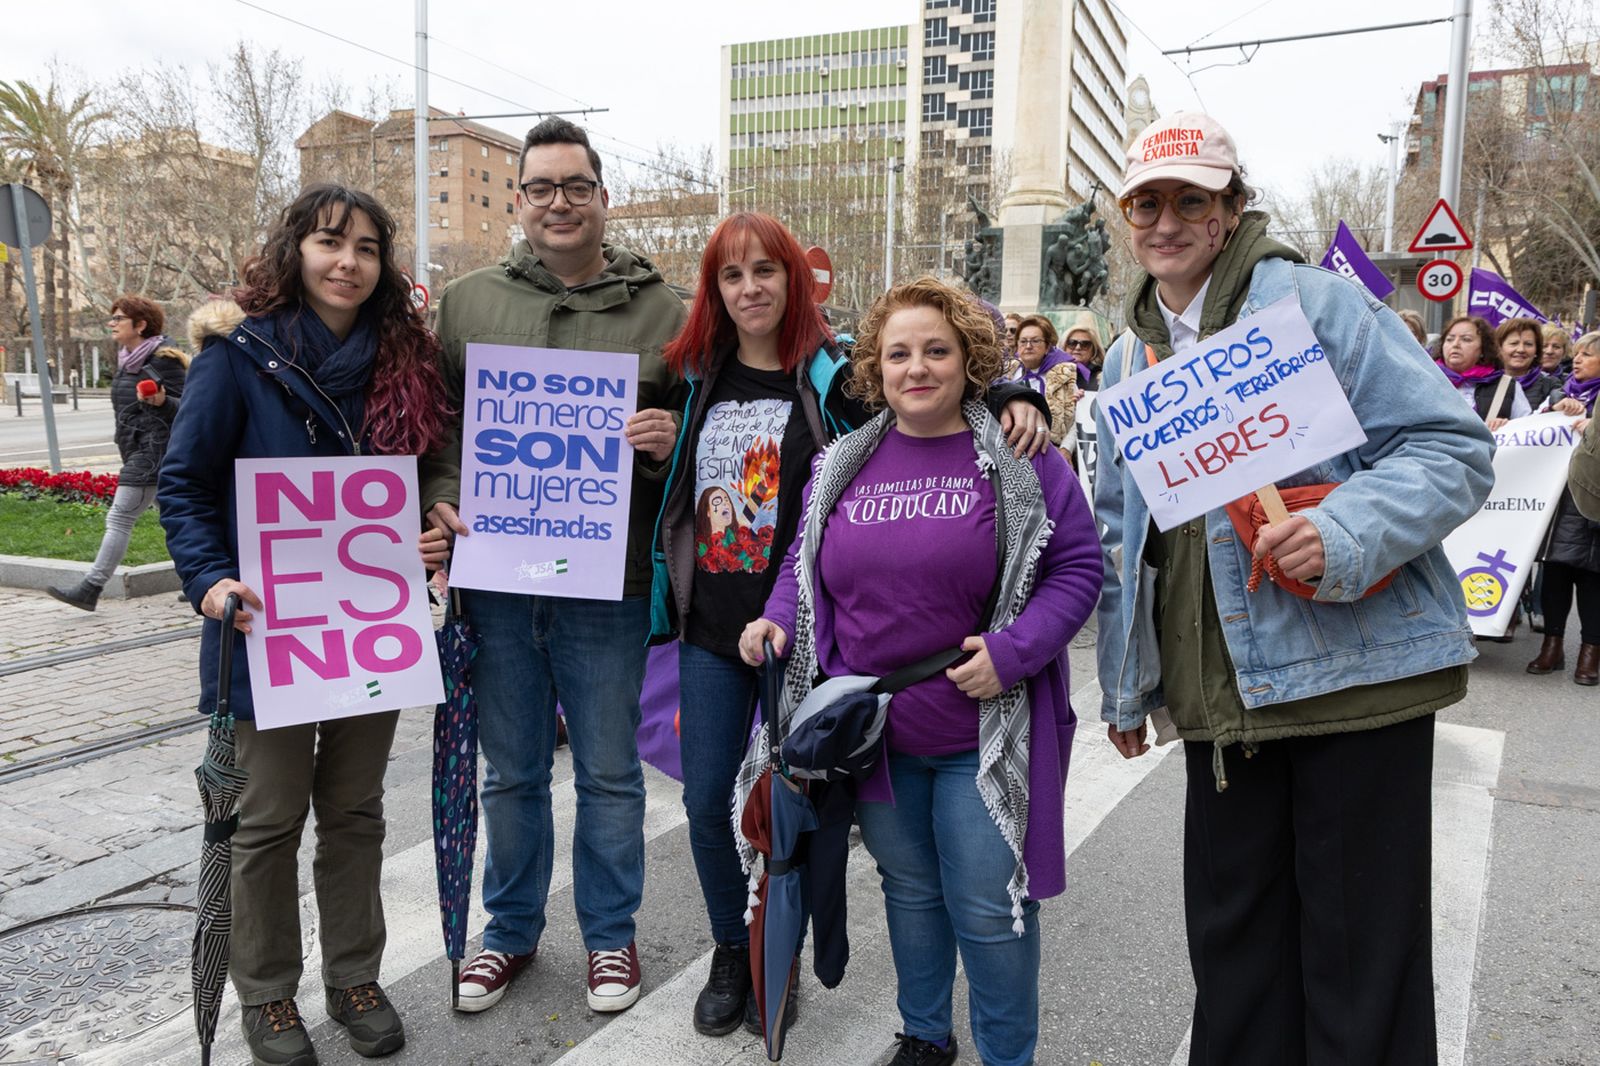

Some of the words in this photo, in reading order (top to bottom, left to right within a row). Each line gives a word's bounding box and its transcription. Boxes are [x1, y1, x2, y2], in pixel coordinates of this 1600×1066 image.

[1142, 128, 1204, 151] FEMINISTA
[1143, 142, 1199, 162] EXAUSTA
[1428, 273, 1452, 287] 30
[478, 369, 537, 393] NO
[543, 374, 626, 398] SON
[1107, 327, 1273, 434] NUESTROS
[477, 391, 624, 432] números
[712, 403, 760, 421] Somos
[764, 401, 785, 418] el
[731, 434, 757, 454] NO
[1123, 397, 1221, 461] CUERPOS
[1221, 403, 1234, 423] y
[474, 428, 621, 473] SON
[698, 454, 744, 481] ESTÁN
[255, 469, 407, 524] NO
[474, 468, 618, 512] mujeres
[855, 485, 871, 498] LAS
[873, 478, 923, 496] FAMILIAS
[926, 476, 937, 488] DE
[941, 476, 974, 490] FAMPA
[850, 493, 969, 523] COEDUCAN
[473, 509, 612, 541] asesinadas
[260, 524, 410, 630] ES
[265, 623, 423, 687] NO
